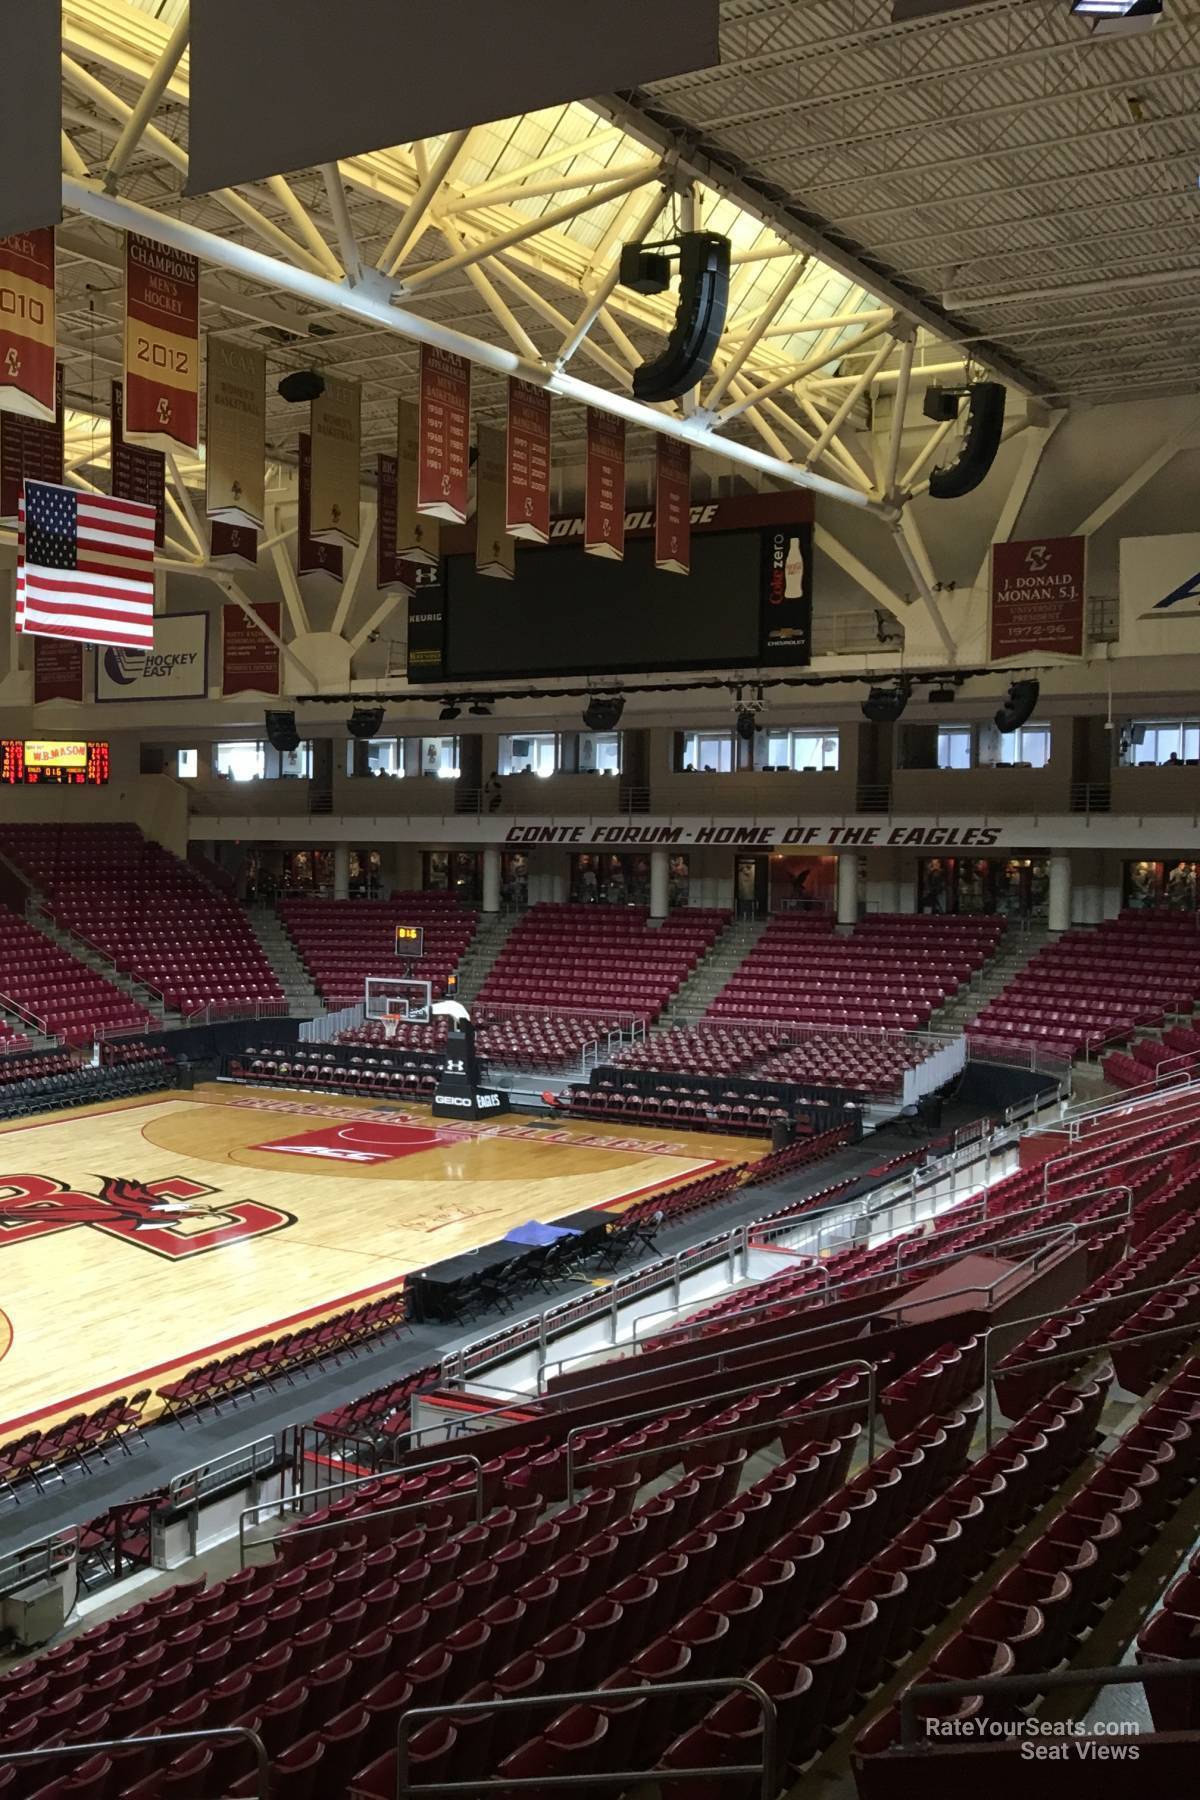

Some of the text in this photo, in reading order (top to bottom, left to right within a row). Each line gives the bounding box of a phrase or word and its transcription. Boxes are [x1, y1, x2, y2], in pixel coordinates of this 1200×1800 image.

[130, 245, 196, 282] CHAMPIONS
[150, 275, 178, 297] MEN'S
[144, 289, 182, 314] HOCKEY
[137, 338, 189, 374] 2012
[773, 533, 784, 568] zero
[1004, 574, 1073, 592] J. DONALD
[997, 586, 1080, 602] MONAN, S.J.
[409, 613, 442, 622] KEURIG
[1008, 624, 1066, 636] 1972-96
[146, 652, 198, 667] HOCKEY
[143, 665, 173, 678] EAST
[505, 826, 585, 842] CONTE
[589, 826, 684, 843] FORUM
[695, 827, 775, 844] HOME
[781, 827, 821, 844] OF
[827, 827, 881, 844] THE
[887, 828, 1003, 846] EAGLES
[434, 1095, 472, 1107] GEICO
[475, 1093, 501, 1109] EAGLES
